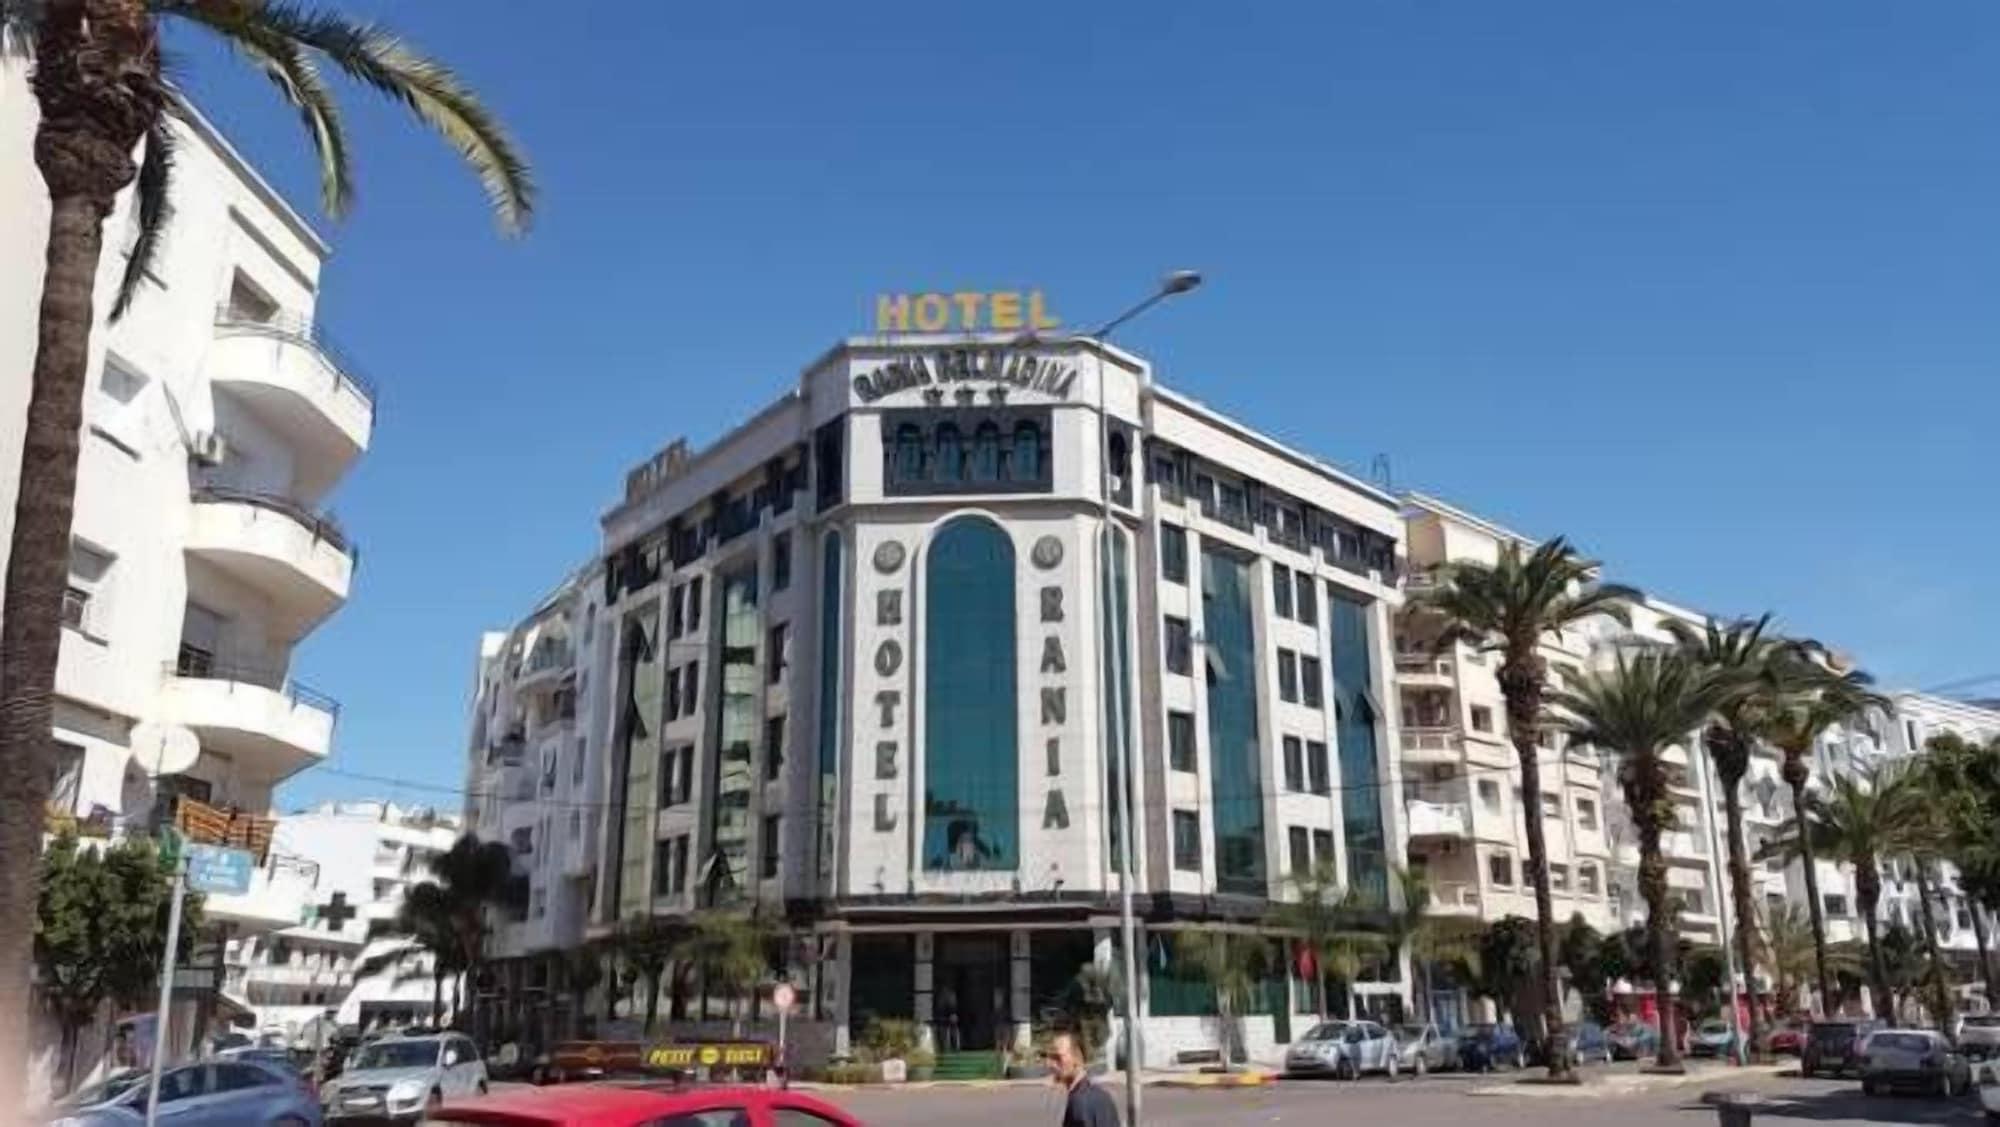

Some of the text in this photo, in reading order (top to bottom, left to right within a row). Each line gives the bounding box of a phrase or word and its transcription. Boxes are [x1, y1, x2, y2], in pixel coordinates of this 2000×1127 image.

[877, 290, 1061, 331] HOTEL
[873, 588, 903, 833] HOTEL
[1040, 585, 1070, 831] RANIA
